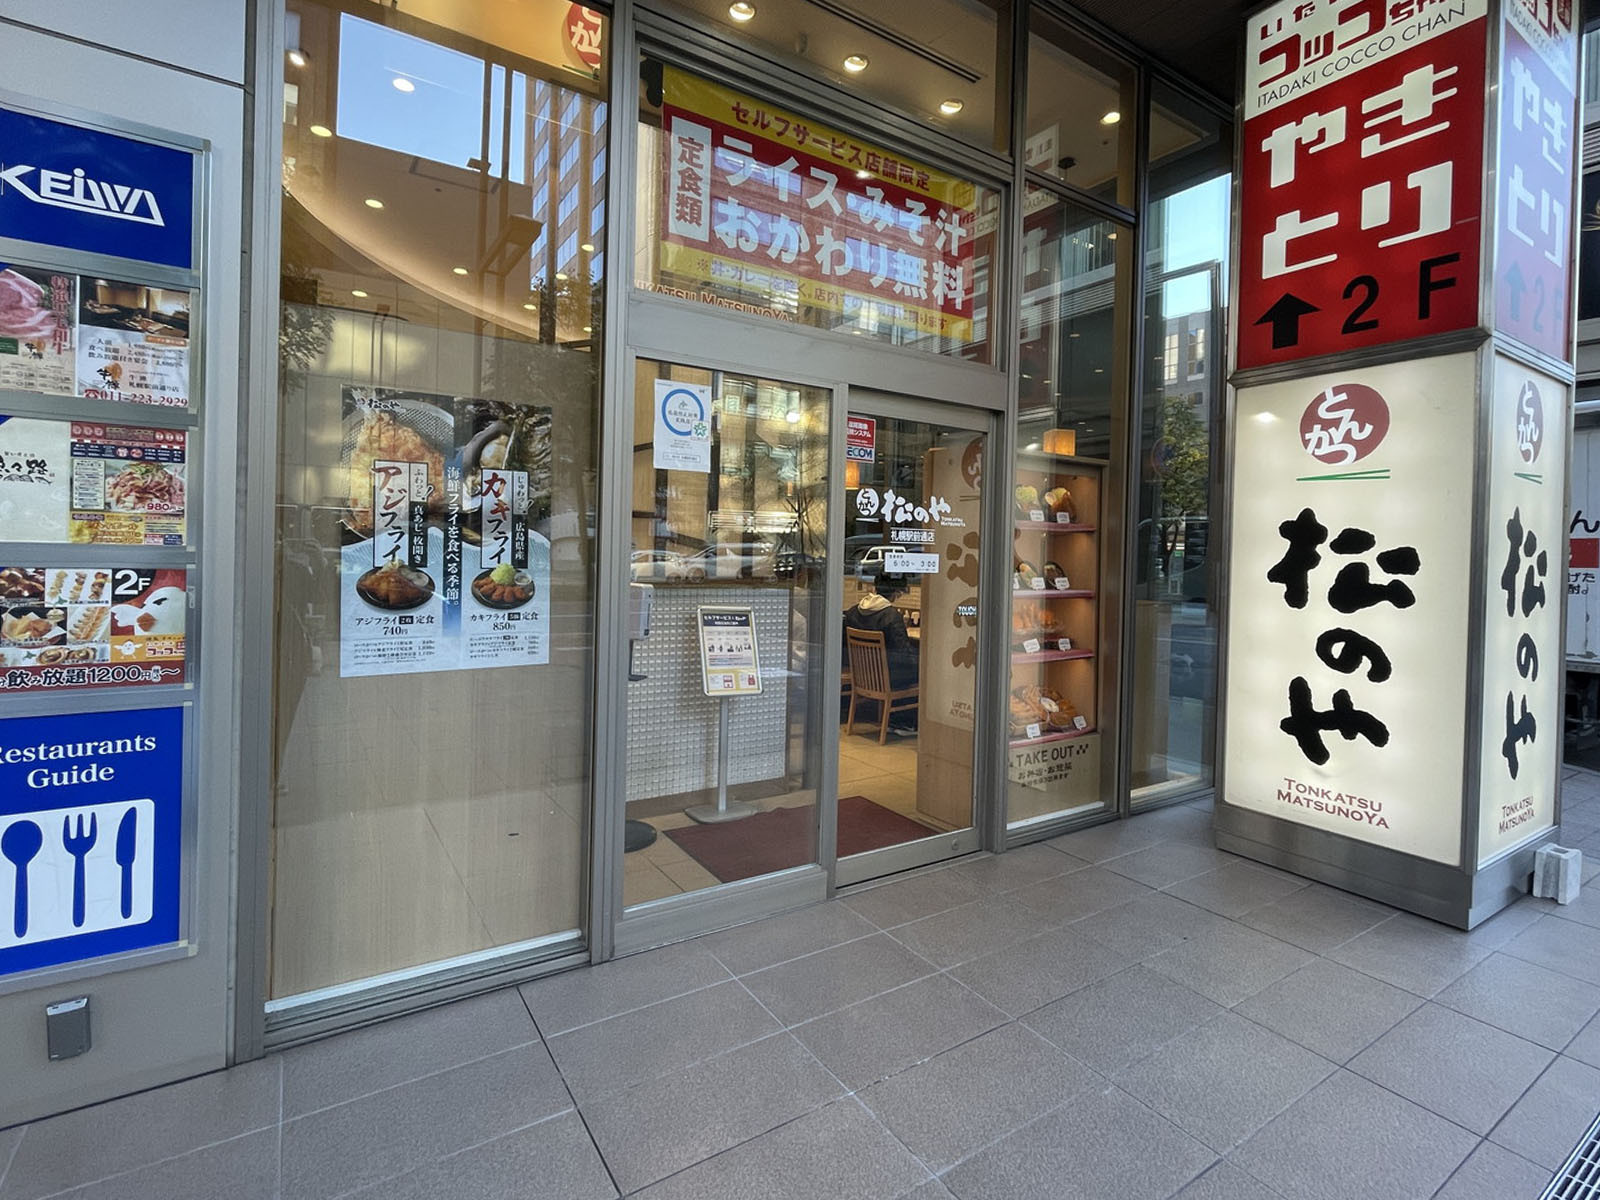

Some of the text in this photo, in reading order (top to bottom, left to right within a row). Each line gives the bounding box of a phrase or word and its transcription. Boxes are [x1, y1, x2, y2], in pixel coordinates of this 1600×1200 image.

[1257, 69, 1317, 109] ITADAKI
[1321, 35, 1396, 78] COCCO
[1402, 1, 1466, 42] CHAN
[731, 101, 931, 192] セルフサービス店舗限定
[1261, 63, 1459, 189] やき
[675, 136, 704, 227] 定食類
[715, 134, 968, 257] ライス・みそ汁
[1261, 160, 1454, 281] とり
[714, 195, 967, 311] おかわり無料
[847, 447, 872, 459] ECOM
[1304, 386, 1374, 466] とんかつ
[371, 466, 407, 562] アジフライ
[446, 466, 460, 606] 海鮮フライを食べる季節。
[481, 472, 510, 564] カキフライ
[114, 569, 151, 596] 2F
[1266, 507, 1421, 766] 松のや
[1501, 506, 1548, 781] 松のや
[0, 735, 157, 764] estaurants
[27, 763, 115, 788] Guide
[1016, 745, 1074, 767] TAKE OUT
[1283, 777, 1383, 813] TONKATSU
[1276, 789, 1390, 830] MATSUNOYA
